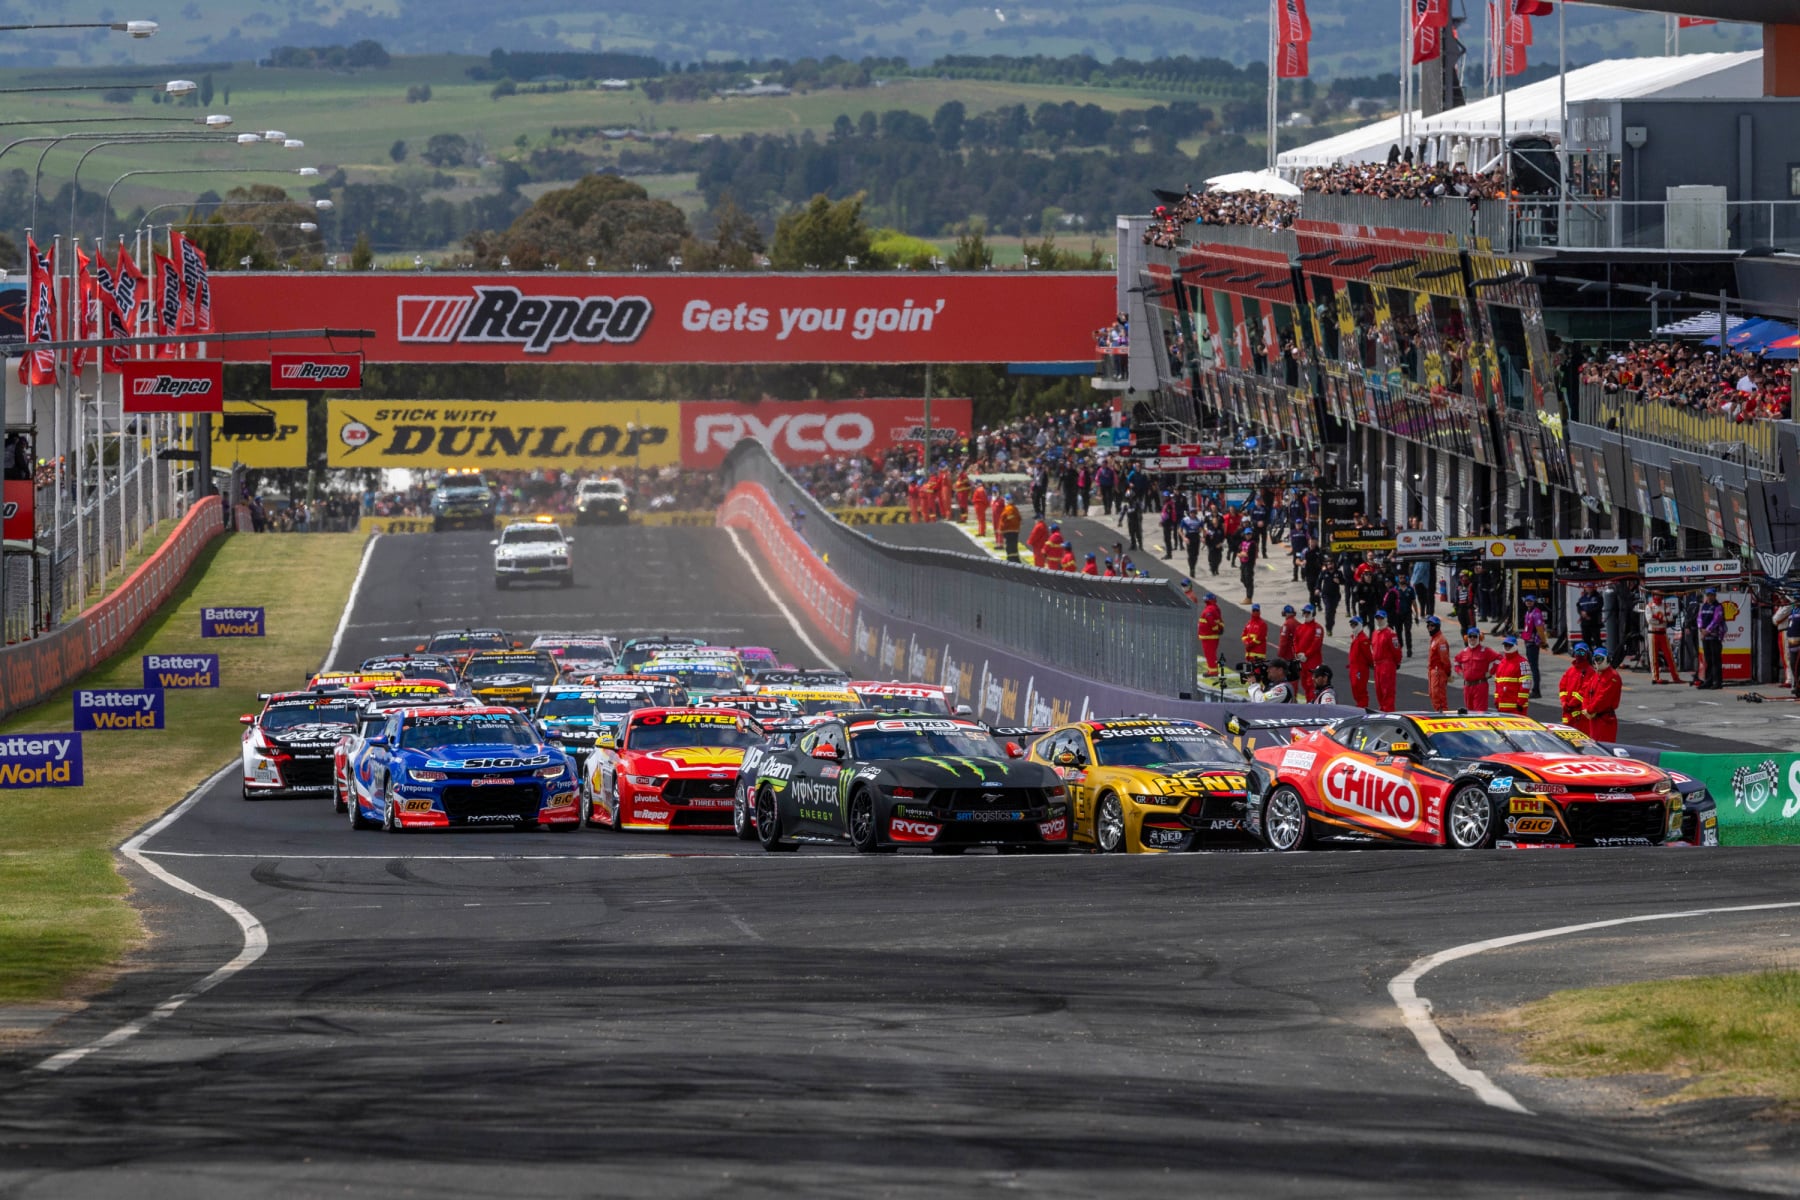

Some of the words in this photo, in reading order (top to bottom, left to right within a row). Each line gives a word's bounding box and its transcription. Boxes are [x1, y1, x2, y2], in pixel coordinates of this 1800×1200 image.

[162, 261, 180, 329] Repco
[457, 285, 652, 352] Repco
[682, 299, 769, 332] Gets
[776, 307, 846, 341] you
[298, 362, 350, 382] Repco
[156, 374, 212, 397] Repco
[375, 409, 438, 421] STICK
[443, 409, 497, 422] WITH
[694, 412, 875, 453] RYCO
[382, 424, 668, 458] DUNLOP
[1362, 529, 1384, 537] TRADIE
[1585, 544, 1619, 556] Repco
[1647, 566, 1677, 574] OPTUS
[205, 608, 259, 621] Battery
[214, 622, 258, 635] World
[148, 656, 212, 672] Battery
[371, 661, 440, 670] DAYCO
[159, 673, 212, 686] World
[317, 677, 347, 686] MAKE
[765, 674, 842, 686] Kubota
[374, 685, 441, 694] PIRTEK
[80, 691, 156, 710] Battery
[695, 701, 799, 712] OPTUS
[92, 711, 156, 729] World
[903, 720, 951, 729] ENZED
[1105, 720, 1172, 728] PENRITE
[1428, 722, 1462, 730] TFH
[1100, 726, 1193, 739] Steadfast
[0, 737, 71, 760] attery
[1360, 736, 1368, 751] 1
[0, 761, 71, 783] World
[791, 778, 840, 807] MONSTER
[1327, 761, 1416, 823] CHIKO
[1534, 784, 1565, 793] PEDDERS
[1136, 795, 1167, 805] GROVE
[1512, 800, 1539, 811] TFH
[641, 809, 669, 820] Repco
[800, 808, 833, 821] ENERGY
[892, 820, 938, 836] RYCO
[1040, 818, 1065, 835] RYCO
[1210, 818, 1243, 831] APEX
[1160, 831, 1183, 841] NED
